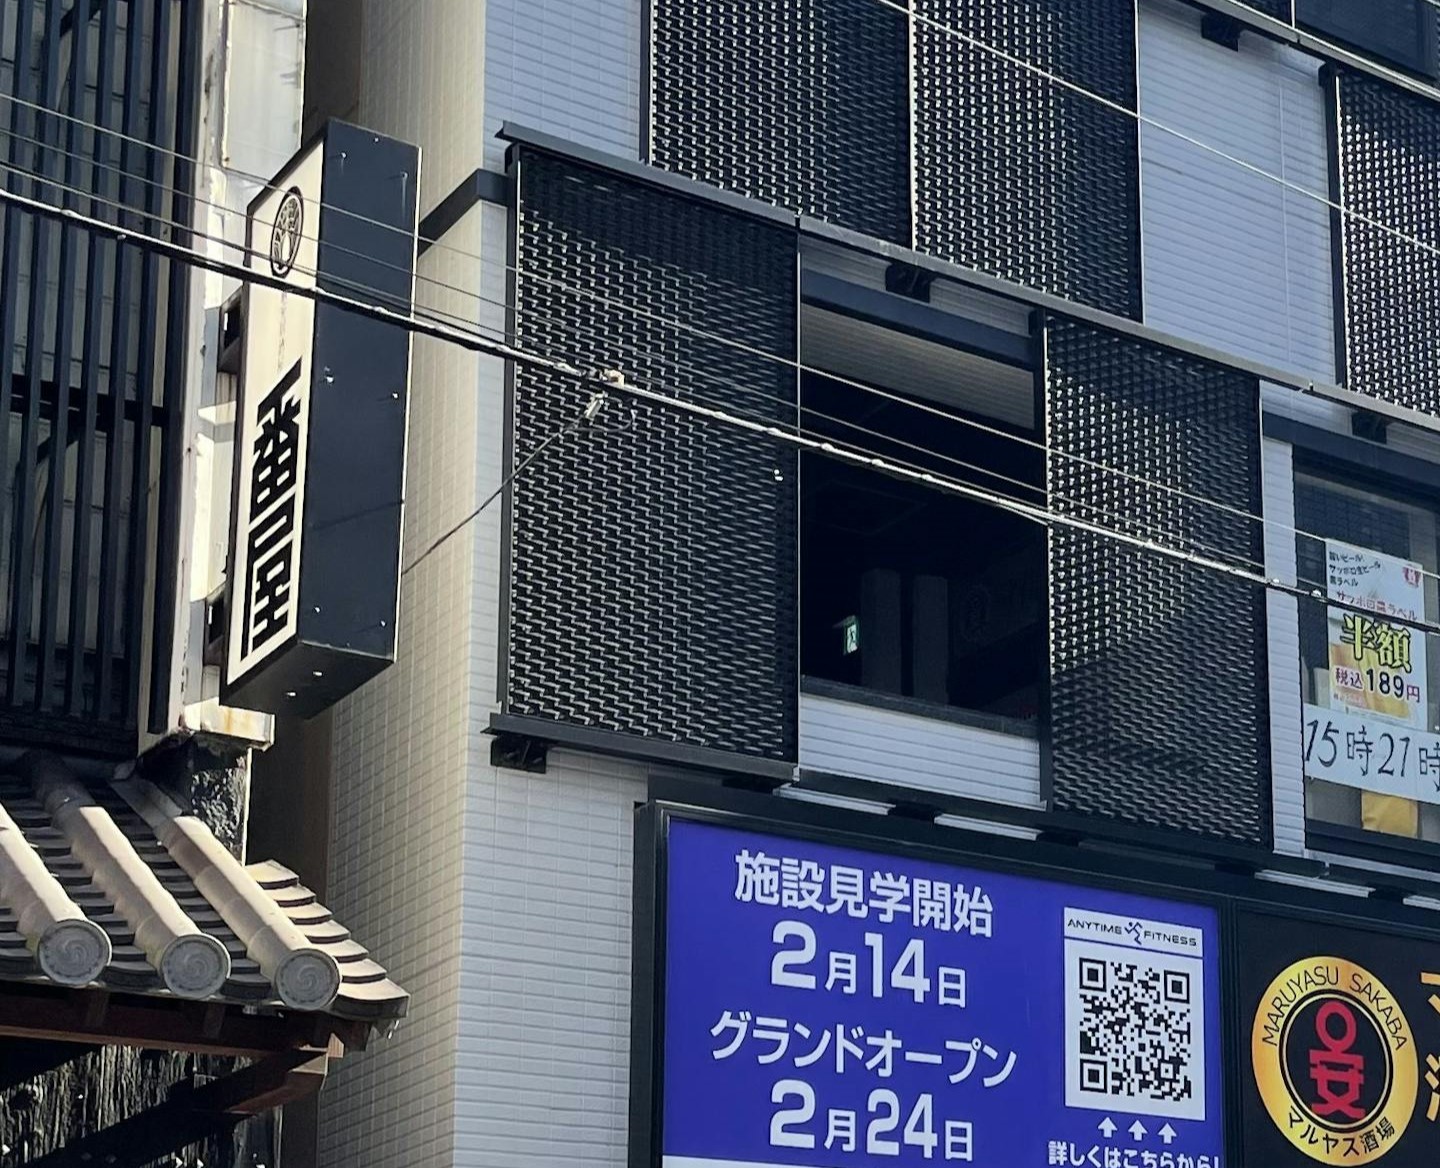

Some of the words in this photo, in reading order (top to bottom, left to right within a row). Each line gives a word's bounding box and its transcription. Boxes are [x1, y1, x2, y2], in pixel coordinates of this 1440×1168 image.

[1340, 613, 1412, 674] 半額
[733, 849, 993, 938] 施設見学開始
[1067, 918, 1124, 936] ANYTIME
[1143, 931, 1198, 948] FITNESS
[770, 921, 967, 1008] 2月14日
[710, 1009, 1017, 1089] グランドオープン
[1261, 965, 1340, 1047] MARUYASU
[1348, 973, 1408, 1052] SAKABA
[768, 1078, 974, 1162] 2月24日
[1287, 1105, 1396, 1158] マルヤス酒場
